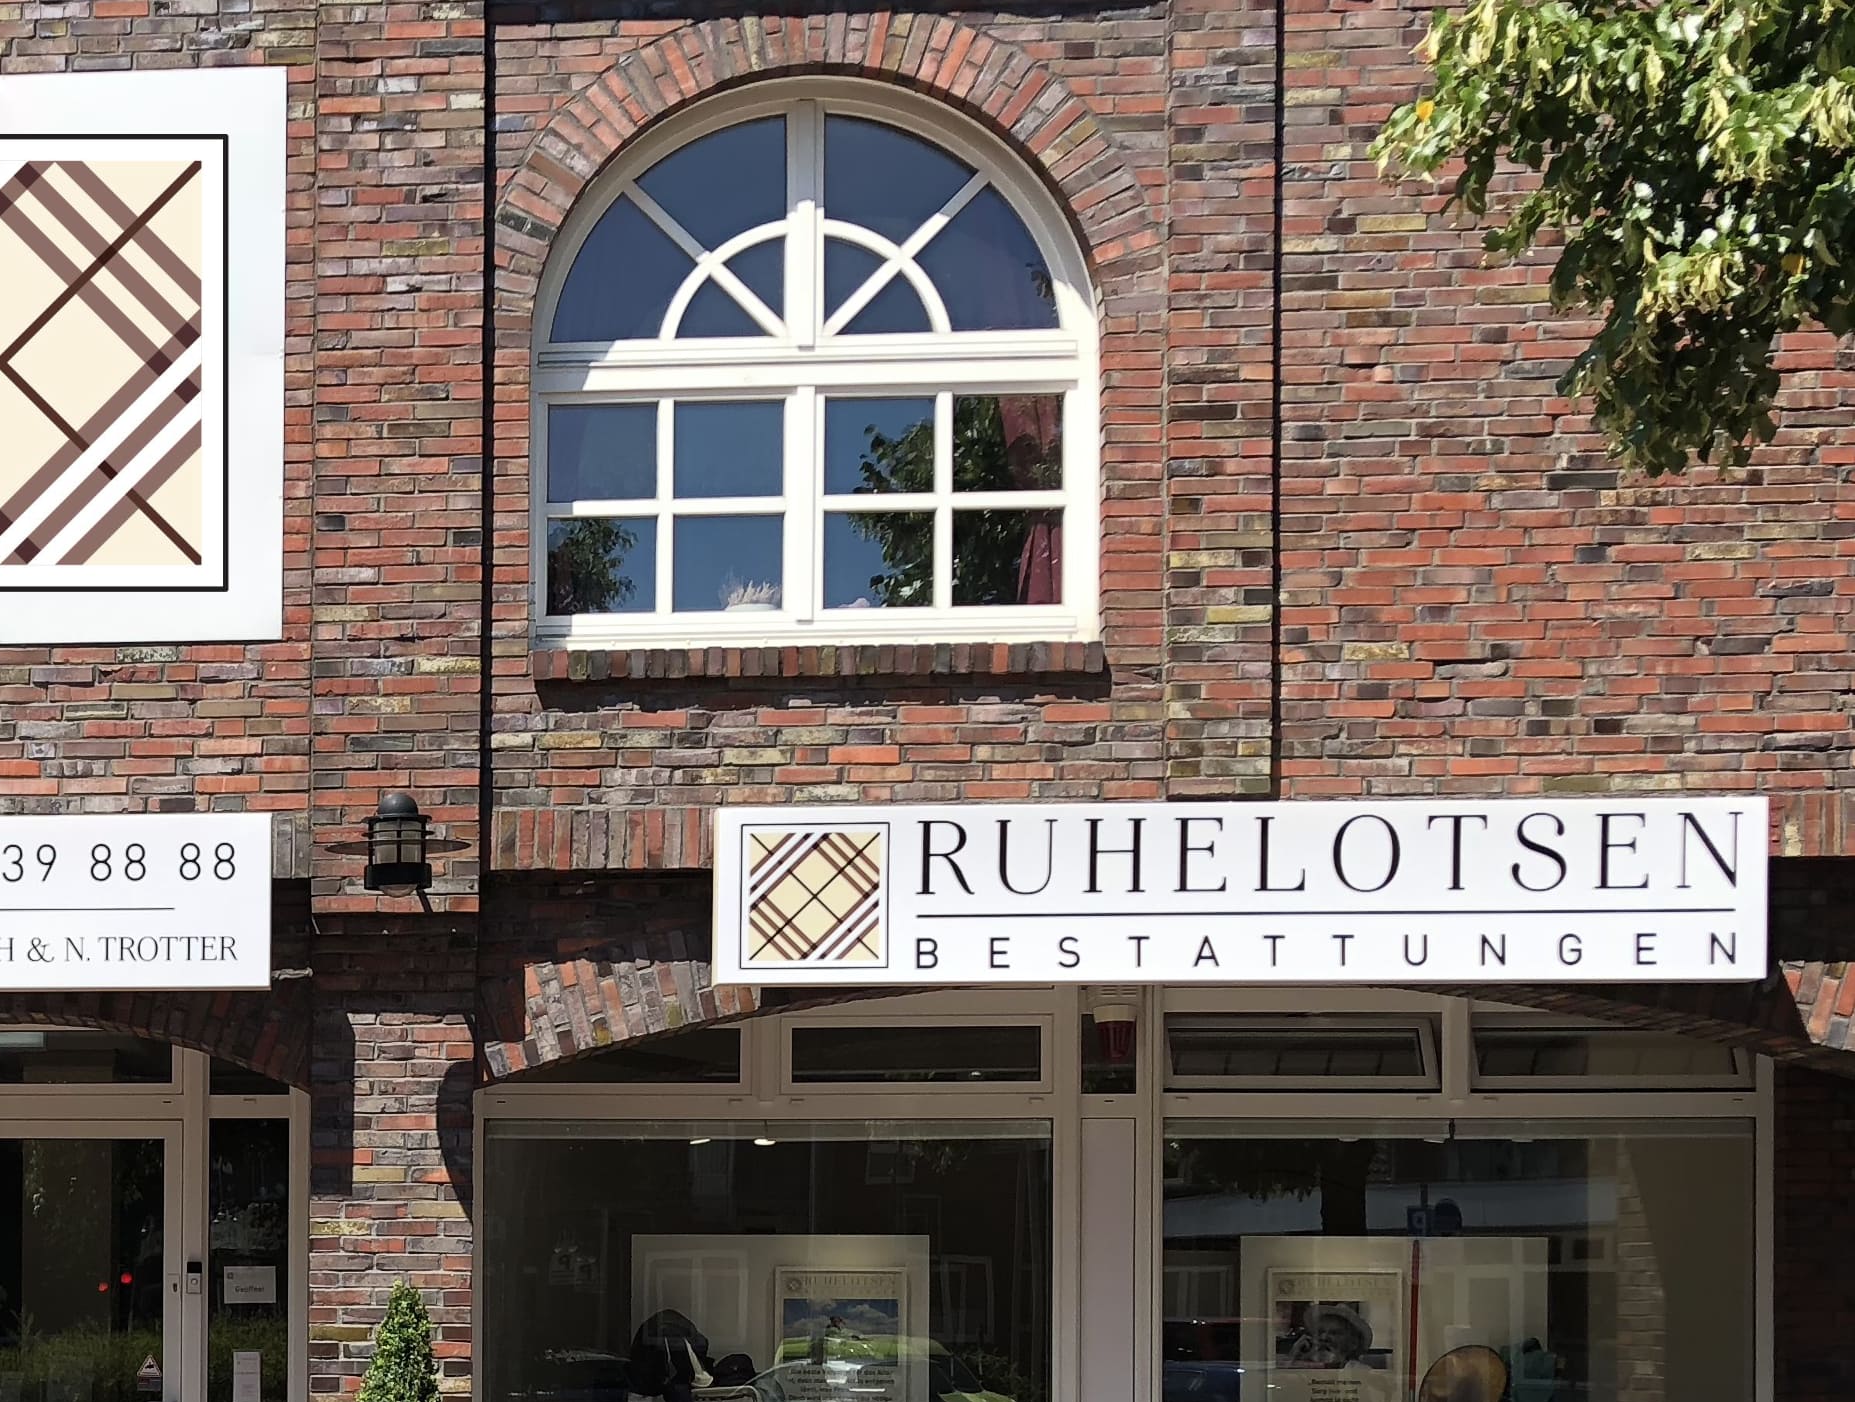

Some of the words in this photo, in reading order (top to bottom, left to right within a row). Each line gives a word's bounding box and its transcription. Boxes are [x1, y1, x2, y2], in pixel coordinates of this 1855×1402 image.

[90, 842, 147, 882] 88
[179, 842, 236, 881] 88
[915, 811, 1743, 895] RUHELOTSEN
[27, 937, 55, 963] &
[66, 937, 90, 962] N.
[98, 936, 238, 962] TROTTER
[916, 932, 1736, 969] BESTATTUNGEN
